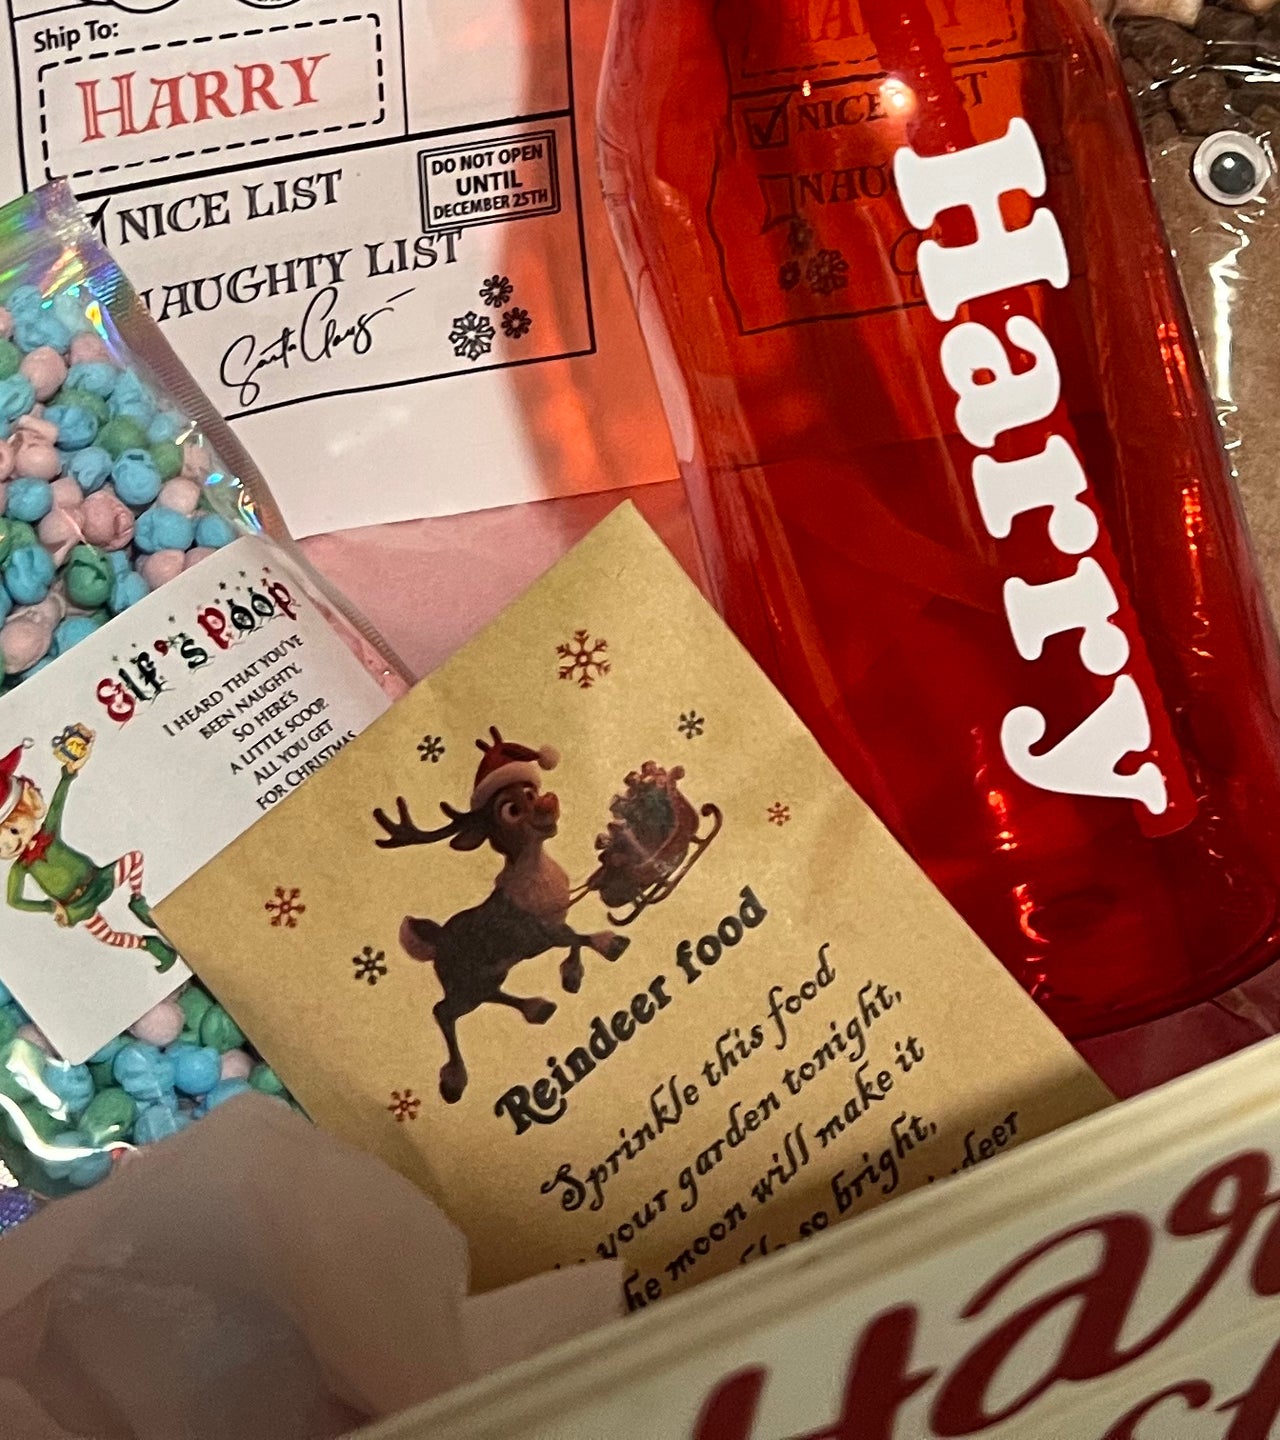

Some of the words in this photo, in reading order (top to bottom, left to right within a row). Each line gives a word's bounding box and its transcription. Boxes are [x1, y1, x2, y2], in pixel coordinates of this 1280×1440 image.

[33, 24, 82, 53] Ship
[83, 20, 119, 42] To:
[74, 53, 331, 144] HARRY
[432, 158, 456, 175] DO
[460, 151, 495, 171] NOT
[498, 143, 543, 164] OPEN
[456, 170, 523, 196] UNTIL
[118, 190, 231, 246] NICE
[240, 169, 343, 217] LIST
[433, 194, 510, 220] DECEMBER
[513, 188, 548, 208] 25TH
[365, 228, 464, 278] LIST
[894, 117, 1168, 817] Harry
[162, 723, 176, 737] I
[173, 690, 224, 730] HEARD
[222, 662, 260, 694] THAT
[199, 708, 237, 740] BEEN
[232, 722, 256, 743] SO
[253, 689, 299, 727] HERE'S
[230, 761, 243, 775] A
[240, 727, 287, 766] LITTLE
[253, 760, 282, 786] ALL
[277, 736, 309, 764] YOU
[308, 718, 334, 742] GET
[256, 783, 288, 811] FOR
[494, 974, 673, 1136] Reindeer
[676, 884, 769, 984] food
[540, 1074, 701, 1212] Sprinkle
[700, 1025, 765, 1090] this
[766, 942, 837, 1051] food
[678, 1092, 781, 1213] garden
[782, 979, 903, 1098] tonight,
[664, 1202, 748, 1281] moon
[750, 1122, 811, 1205] will
[813, 1069, 896, 1148] make
[895, 1034, 926, 1072] it
[799, 1211, 830, 1240] so
[831, 1110, 937, 1216] bright,
